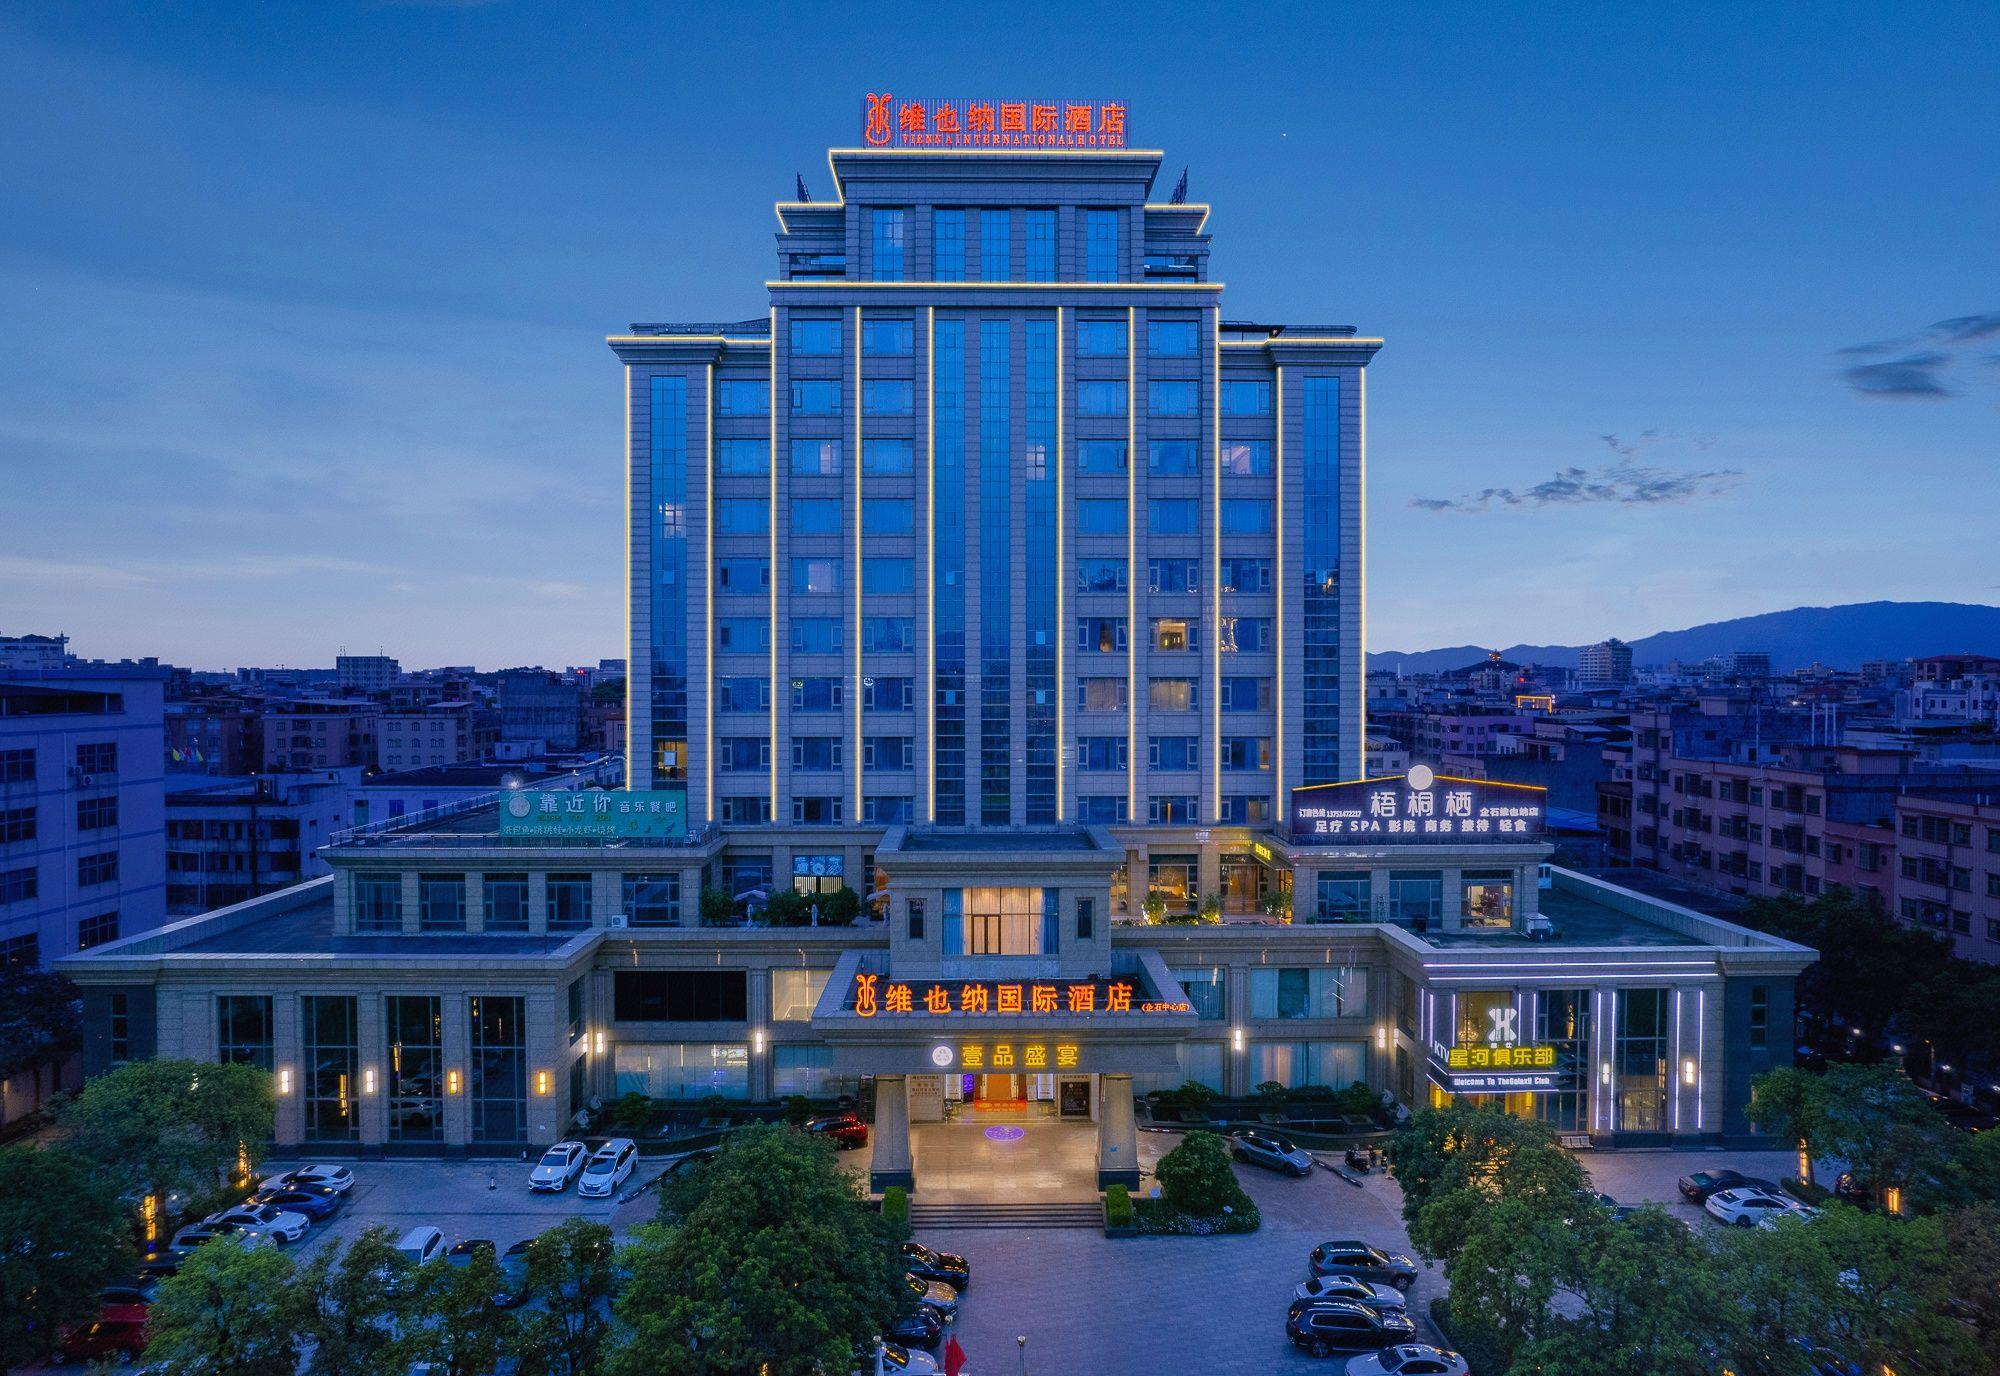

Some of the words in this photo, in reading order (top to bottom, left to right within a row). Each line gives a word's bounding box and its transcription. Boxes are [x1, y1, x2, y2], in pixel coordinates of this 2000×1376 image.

[898, 103, 1126, 133] 维也纳国际酒店
[539, 793, 612, 813] 靠近你
[619, 801, 677, 813] 音乐餐吧
[1370, 791, 1472, 818] 梧桐栖
[1315, 819, 1343, 833] 足疗
[1351, 820, 1381, 832] SPA
[1388, 819, 1416, 833] 影院
[1424, 819, 1452, 833] 商务
[1461, 819, 1490, 833] 接待
[1499, 819, 1528, 833] 轻食
[885, 983, 1133, 1014] 维也纳国际酒店
[962, 1044, 1079, 1067] 壹品盛宴
[1434, 1040, 1450, 1062] KTV
[1449, 1047, 1553, 1066] 星河俱乐部
[1454, 1077, 1485, 1086] Welcome
[1487, 1077, 1496, 1086] To
[1534, 1076, 1550, 1085] Club
